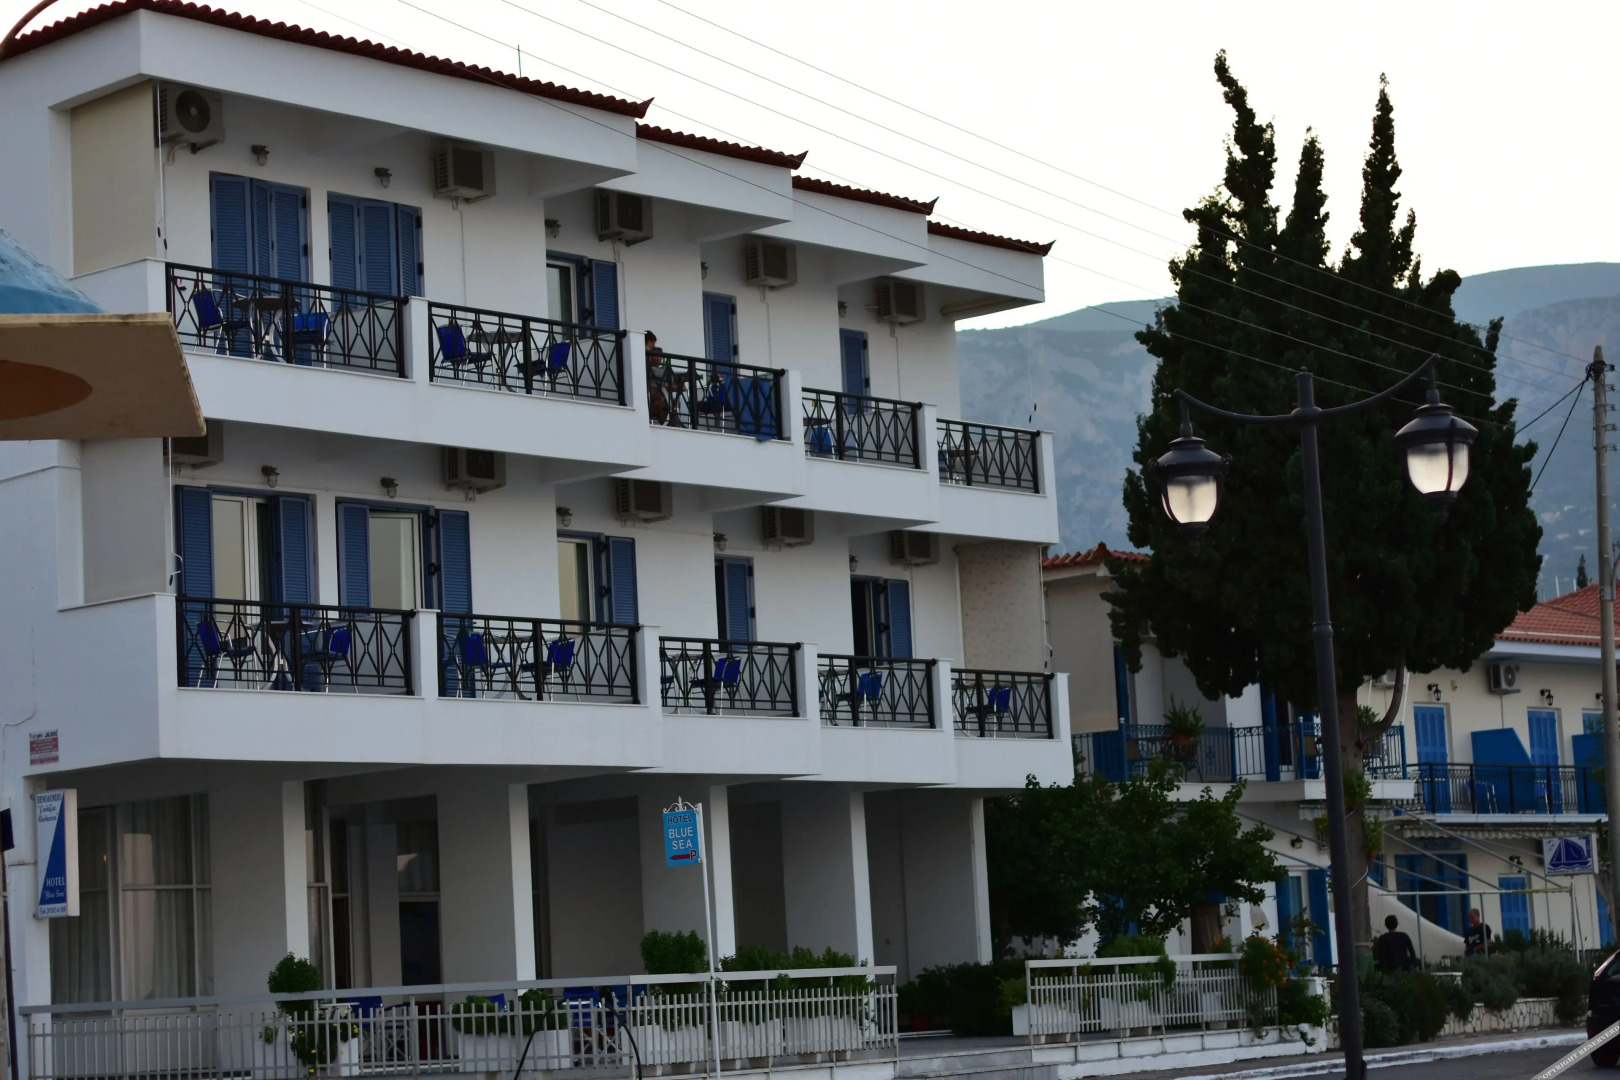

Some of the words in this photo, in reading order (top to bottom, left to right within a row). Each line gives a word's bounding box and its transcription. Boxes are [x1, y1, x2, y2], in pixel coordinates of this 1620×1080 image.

[668, 815, 692, 824] HOTEL
[669, 827, 693, 838] BLUE
[672, 839, 692, 850] SEA
[46, 877, 65, 887] HOTEL
